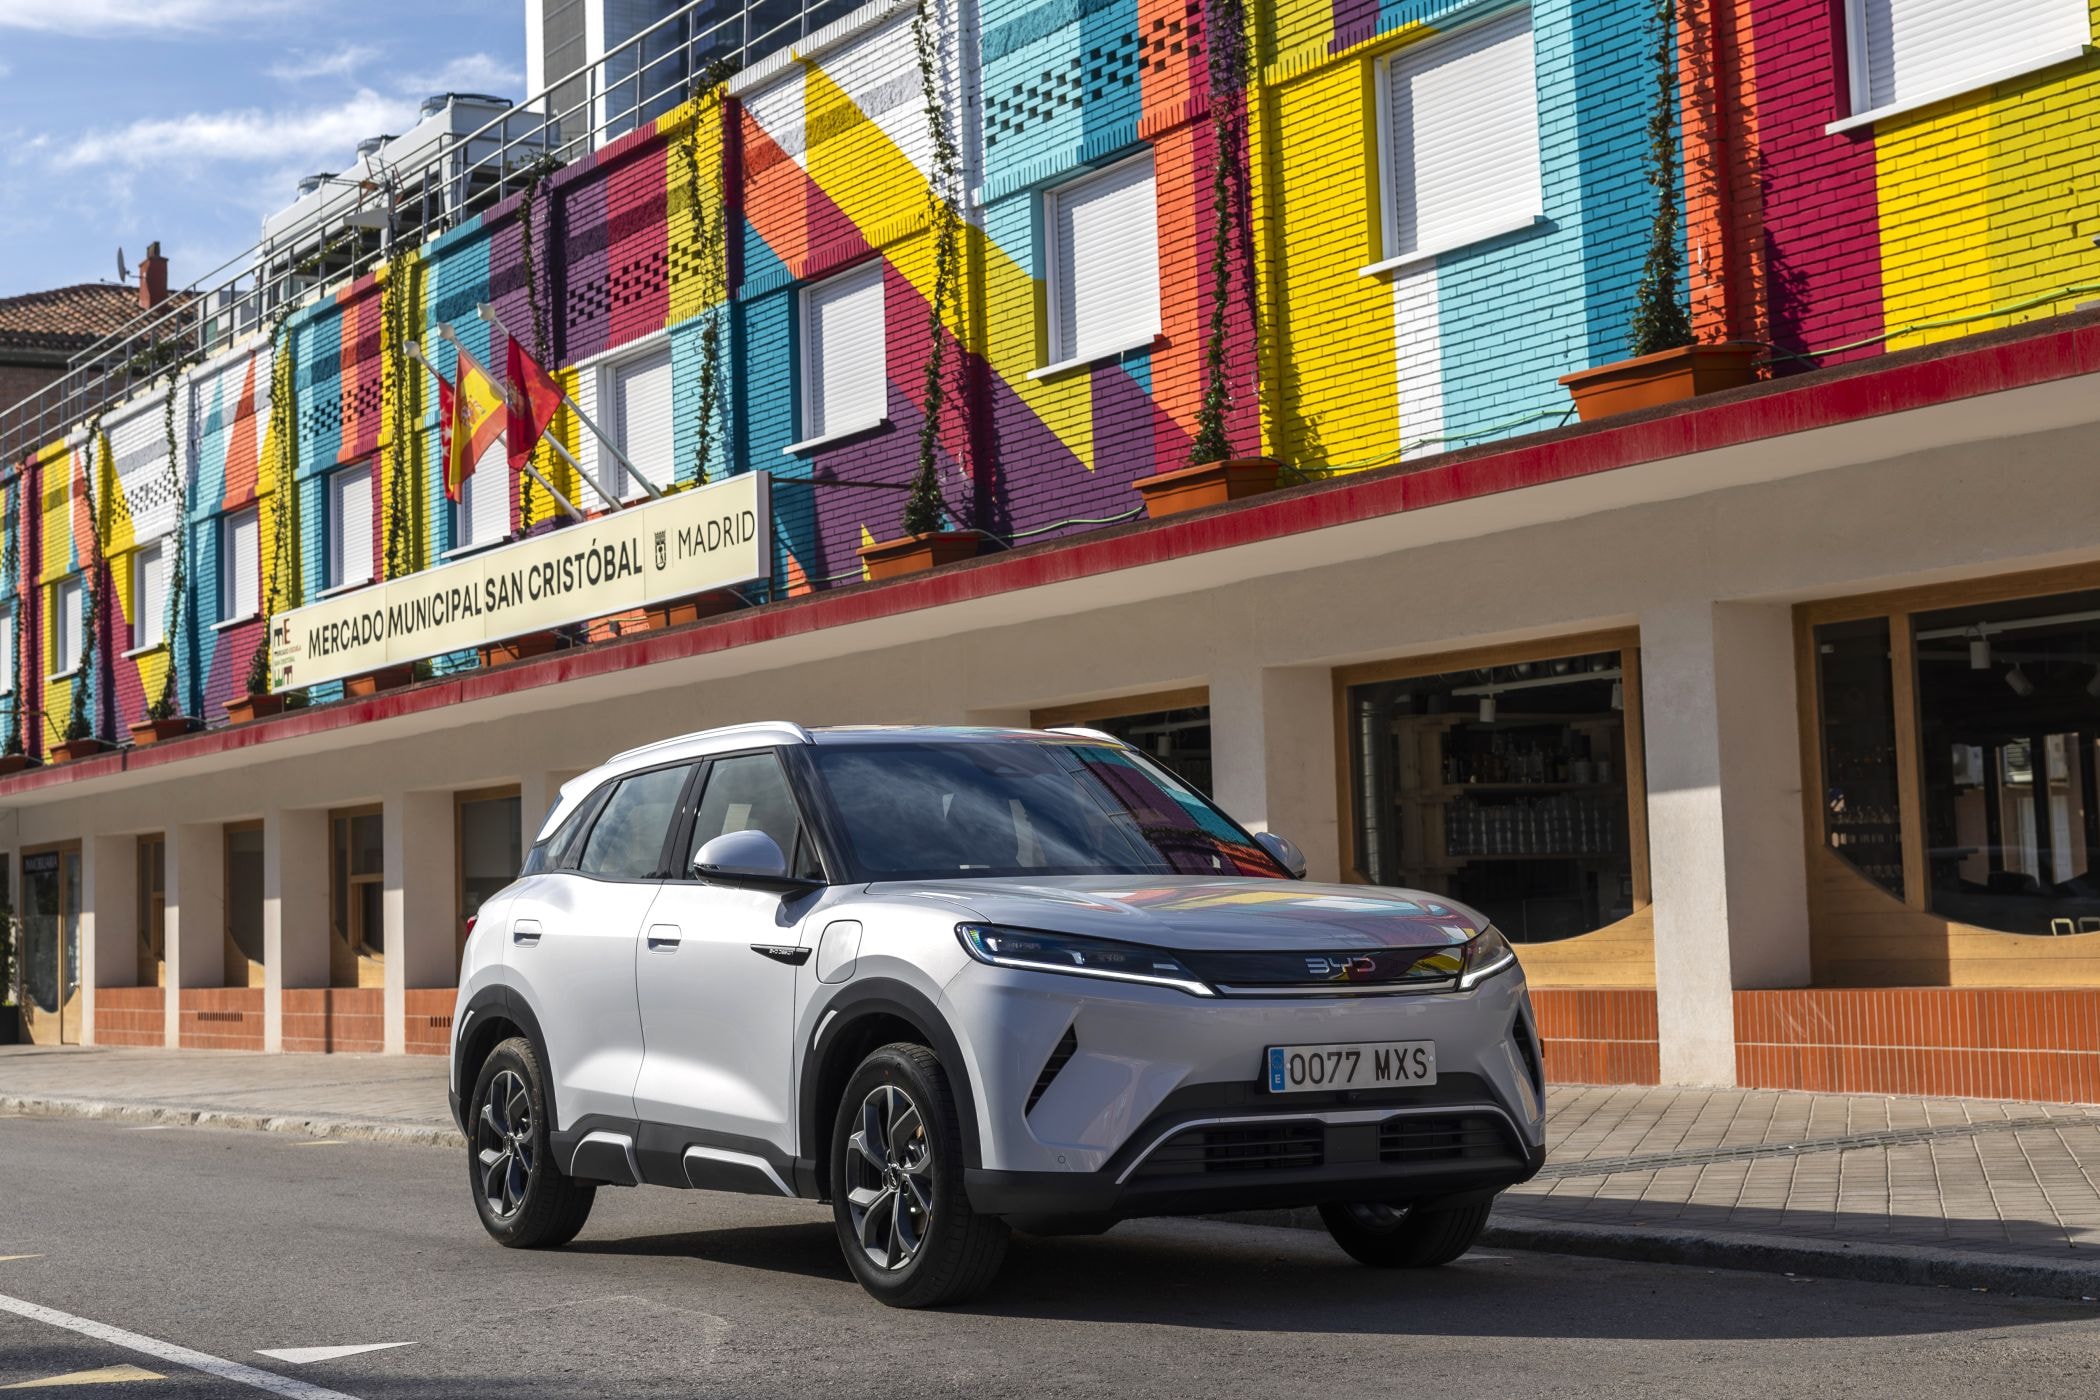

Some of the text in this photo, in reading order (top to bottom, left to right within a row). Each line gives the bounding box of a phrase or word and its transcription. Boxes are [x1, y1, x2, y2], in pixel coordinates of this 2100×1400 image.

[678, 510, 755, 560] MADRID
[308, 538, 642, 660] MERCADO MUNICIPAL SAN CRISTÓBAL
[1305, 957, 1376, 974] BYD
[1274, 1073, 1281, 1084] E
[1289, 1047, 1428, 1086] 0077 MXS
